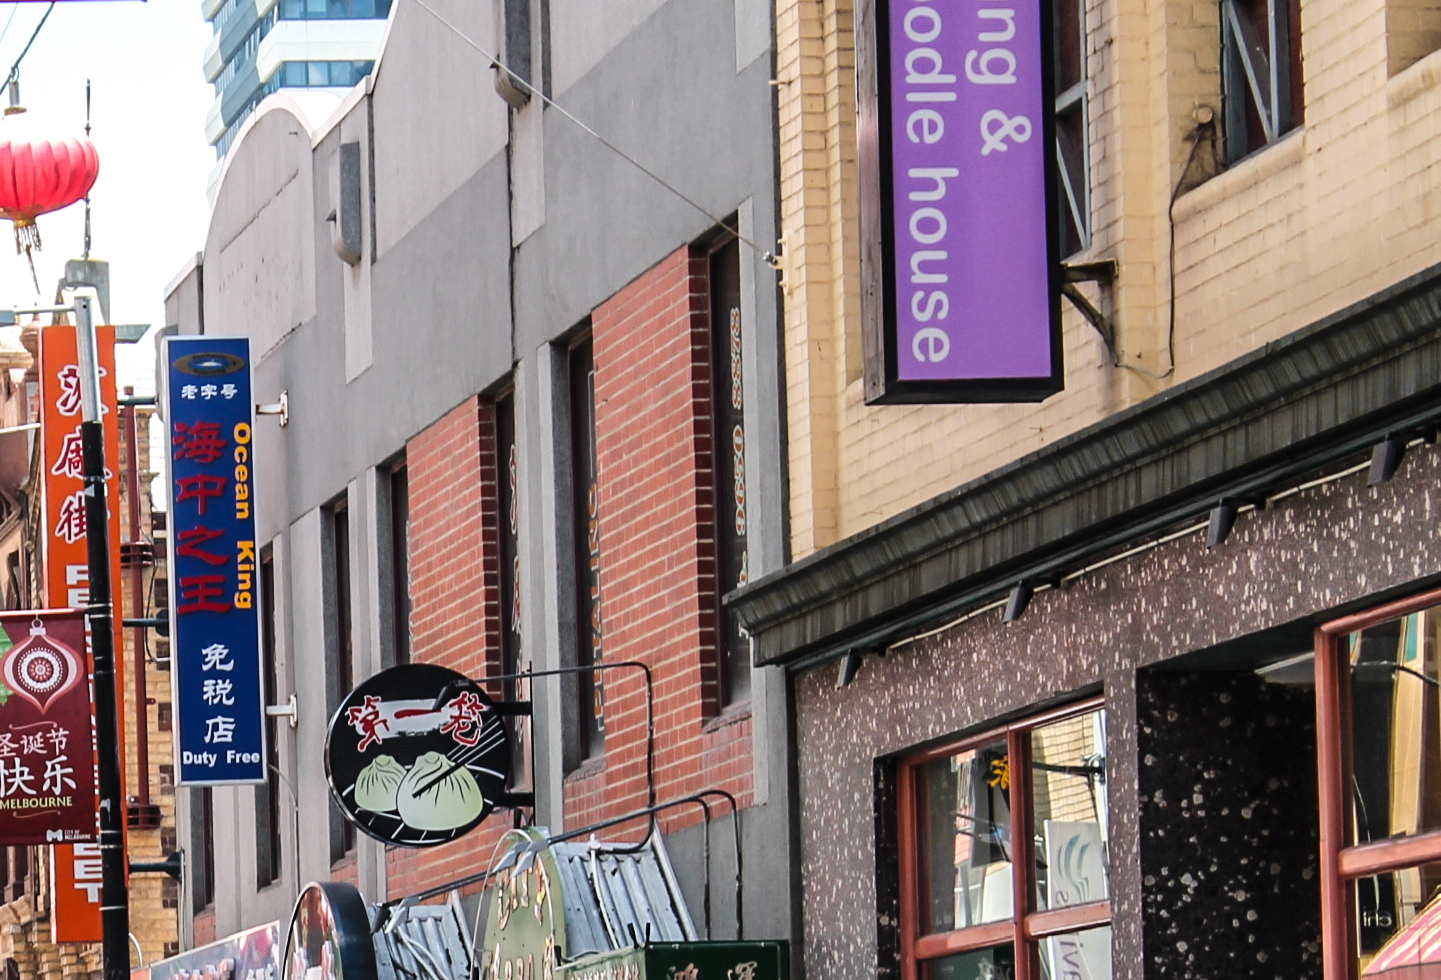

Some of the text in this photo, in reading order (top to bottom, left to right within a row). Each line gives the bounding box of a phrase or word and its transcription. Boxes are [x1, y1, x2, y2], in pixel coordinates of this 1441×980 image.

[903, 0, 959, 363] odle house
[980, 109, 1032, 155] &
[172, 420, 232, 615] 海中之王
[234, 422, 255, 610] Ocean King
[201, 643, 235, 744] 免税店
[0, 796, 73, 809] MELBOURNE
[182, 750, 260, 767] Duty Free
